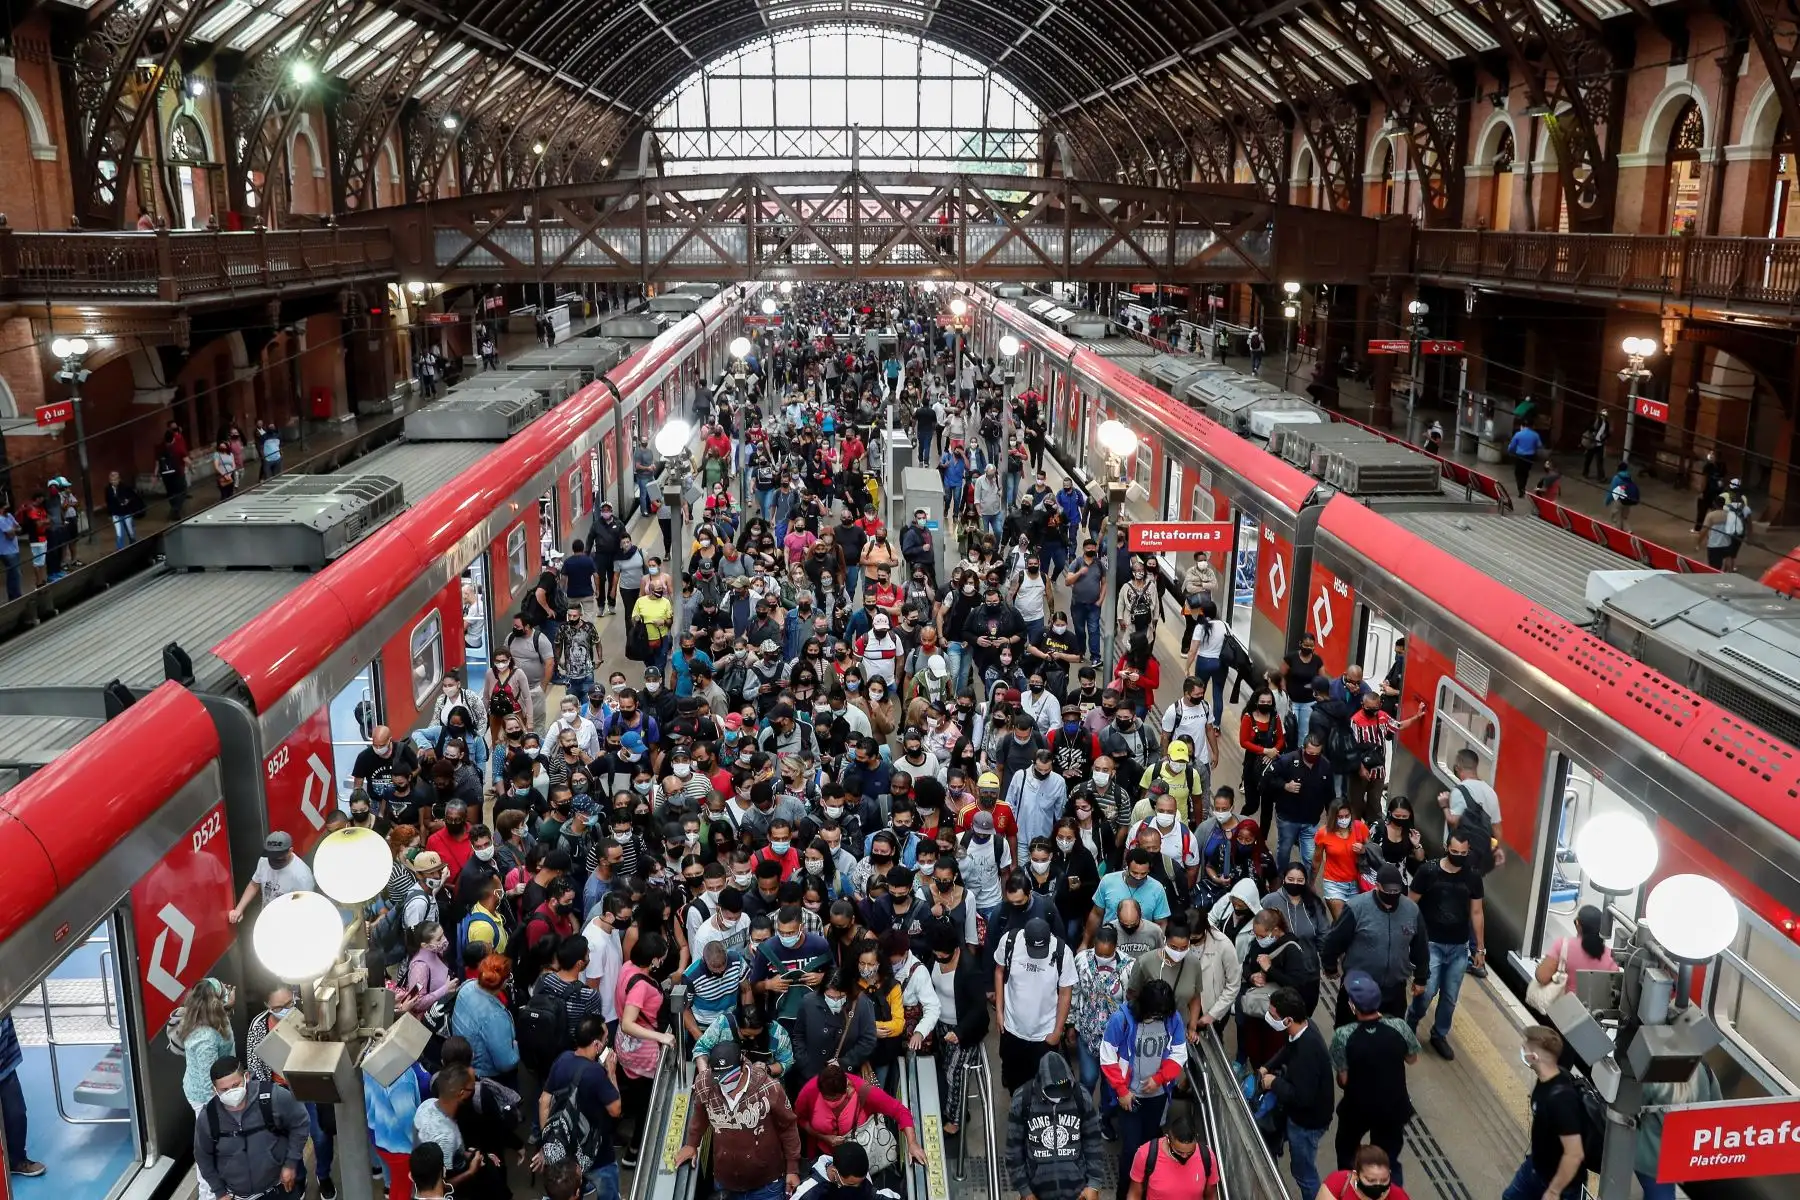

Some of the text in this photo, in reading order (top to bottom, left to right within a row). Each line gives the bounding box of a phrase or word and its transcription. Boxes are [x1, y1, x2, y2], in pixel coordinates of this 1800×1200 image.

[1650, 406, 1660, 417] Luz
[1141, 529, 1221, 540] Plataforma 3
[1333, 576, 1348, 598] H546
[267, 745, 289, 780] 9522
[192, 811, 221, 854] D522
[1027, 1114, 1080, 1132] LONG WAVE
[1034, 1150, 1053, 1158] ATHL.
[1689, 1153, 1746, 1167] Platform
